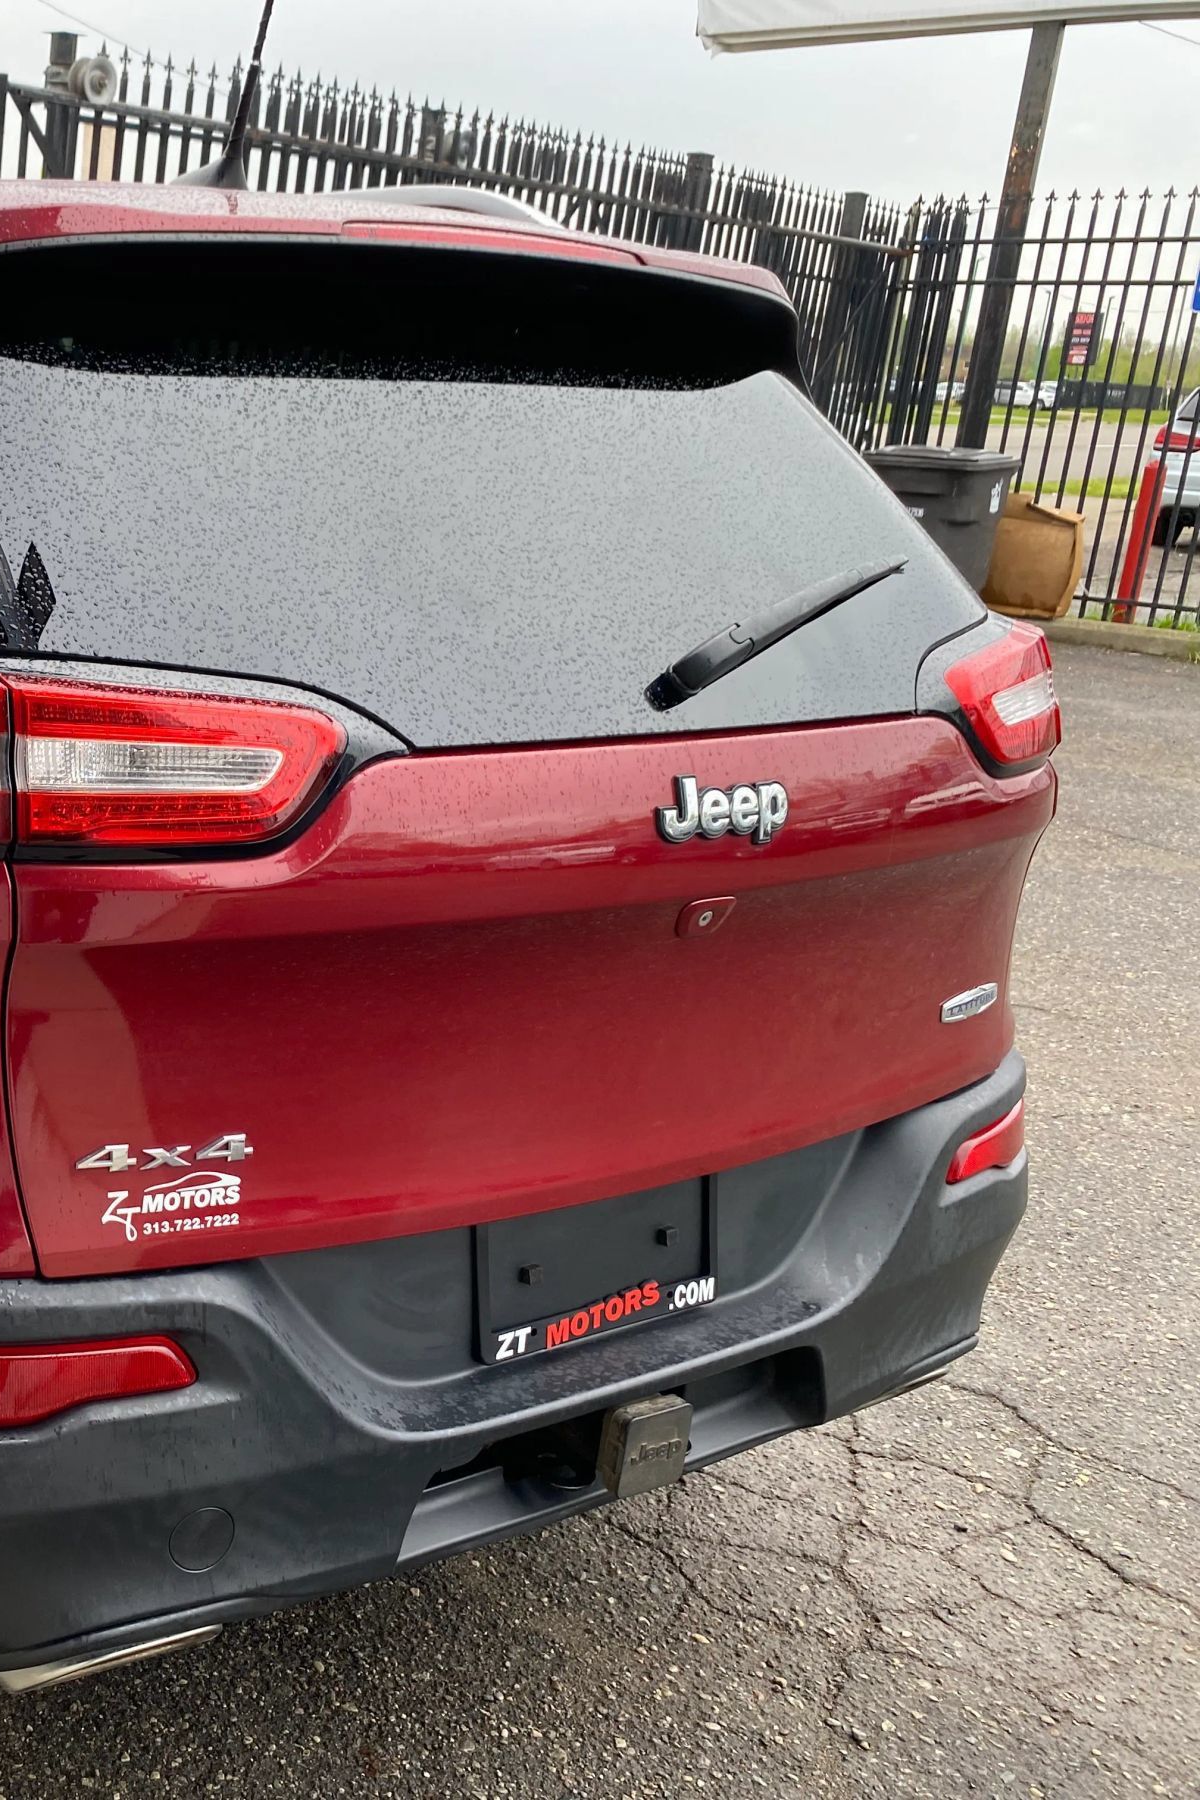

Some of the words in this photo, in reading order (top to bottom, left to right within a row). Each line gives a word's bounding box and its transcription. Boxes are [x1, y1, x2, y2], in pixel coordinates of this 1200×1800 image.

[656, 774, 790, 845] Jeep
[947, 989, 996, 1016] LATITUDE
[75, 1133, 254, 1172] 4x4
[101, 1191, 141, 1242] ZT
[141, 1185, 241, 1214] MOTORS
[143, 1213, 240, 1236] 313.722.7222
[495, 1326, 532, 1361] ZT
[545, 1280, 661, 1350] MOTORS
[668, 1277, 715, 1311] .COM
[630, 1438, 682, 1467] Jeep
